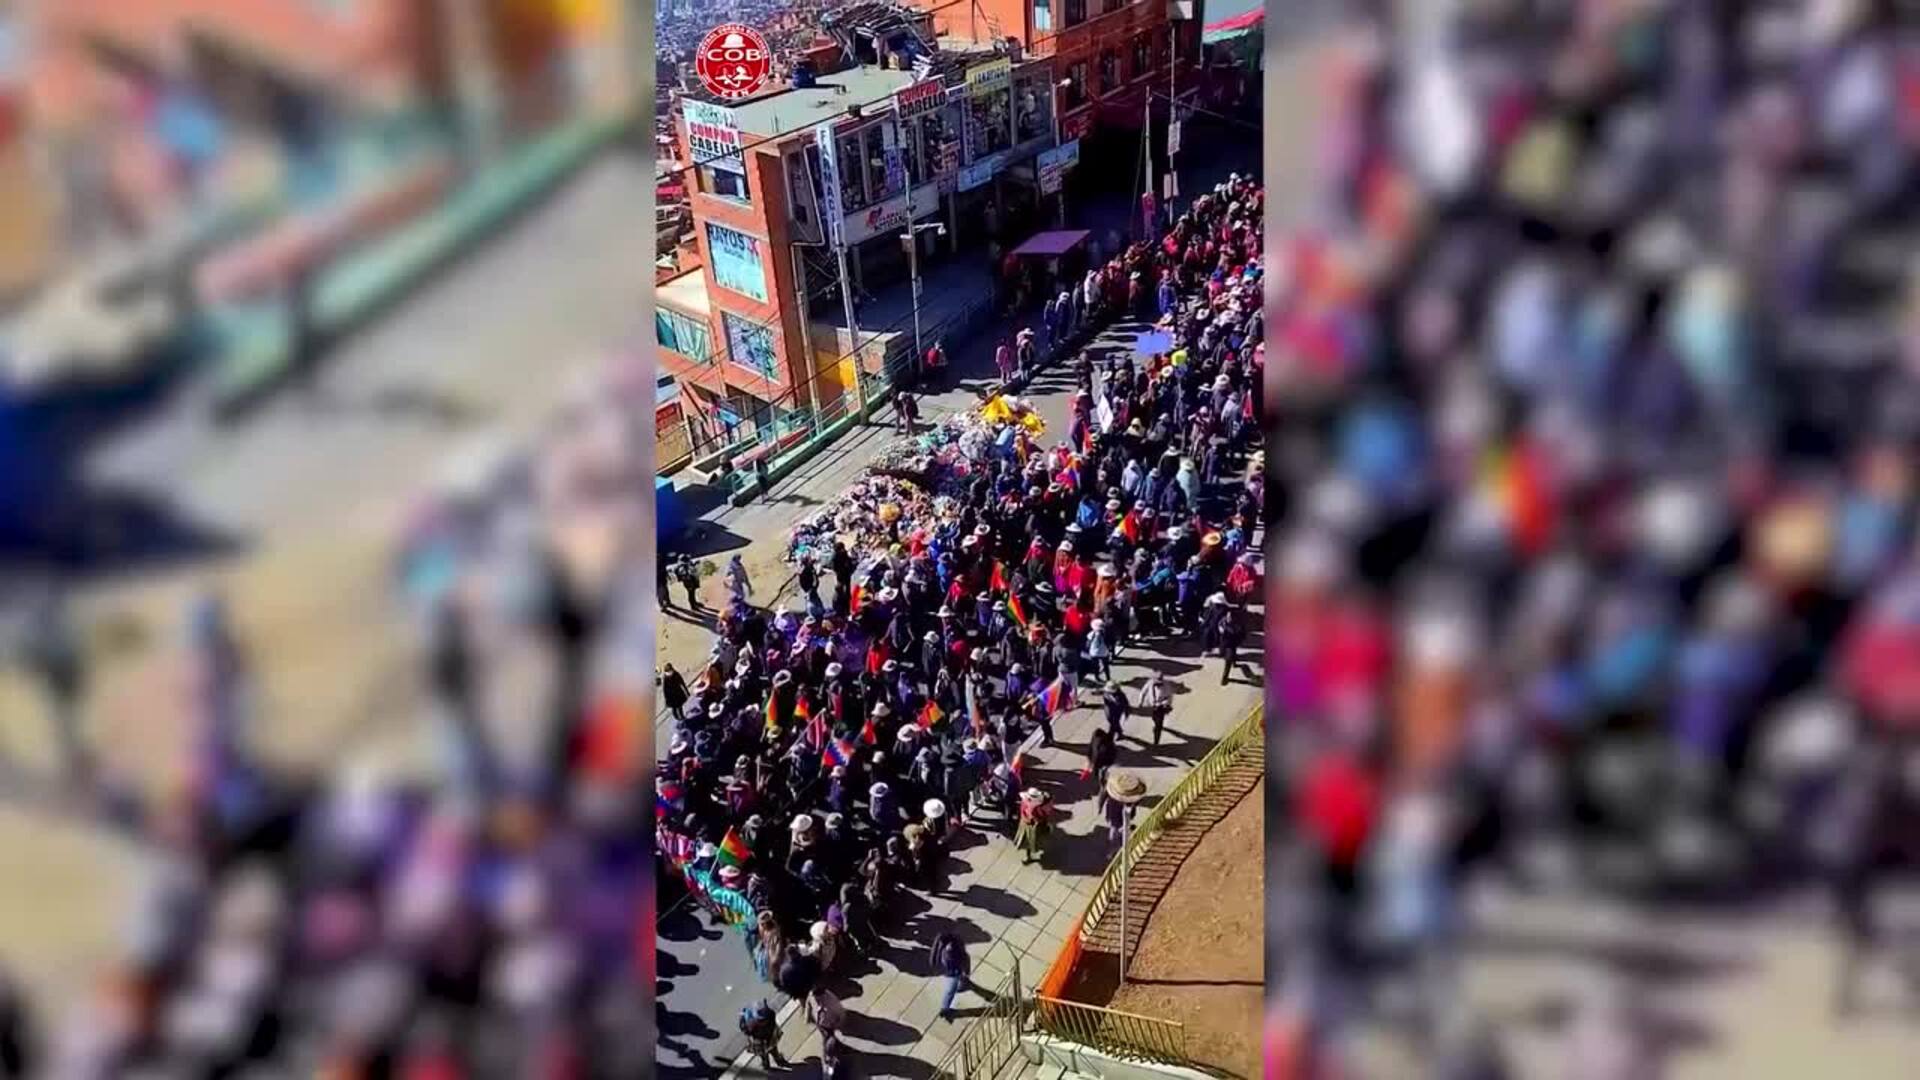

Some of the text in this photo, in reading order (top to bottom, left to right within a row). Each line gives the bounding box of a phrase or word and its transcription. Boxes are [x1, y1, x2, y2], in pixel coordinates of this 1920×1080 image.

[899, 91, 946, 119] CABELLO
[689, 122, 735, 145] COMPRO
[689, 134, 740, 159] CABELLO
